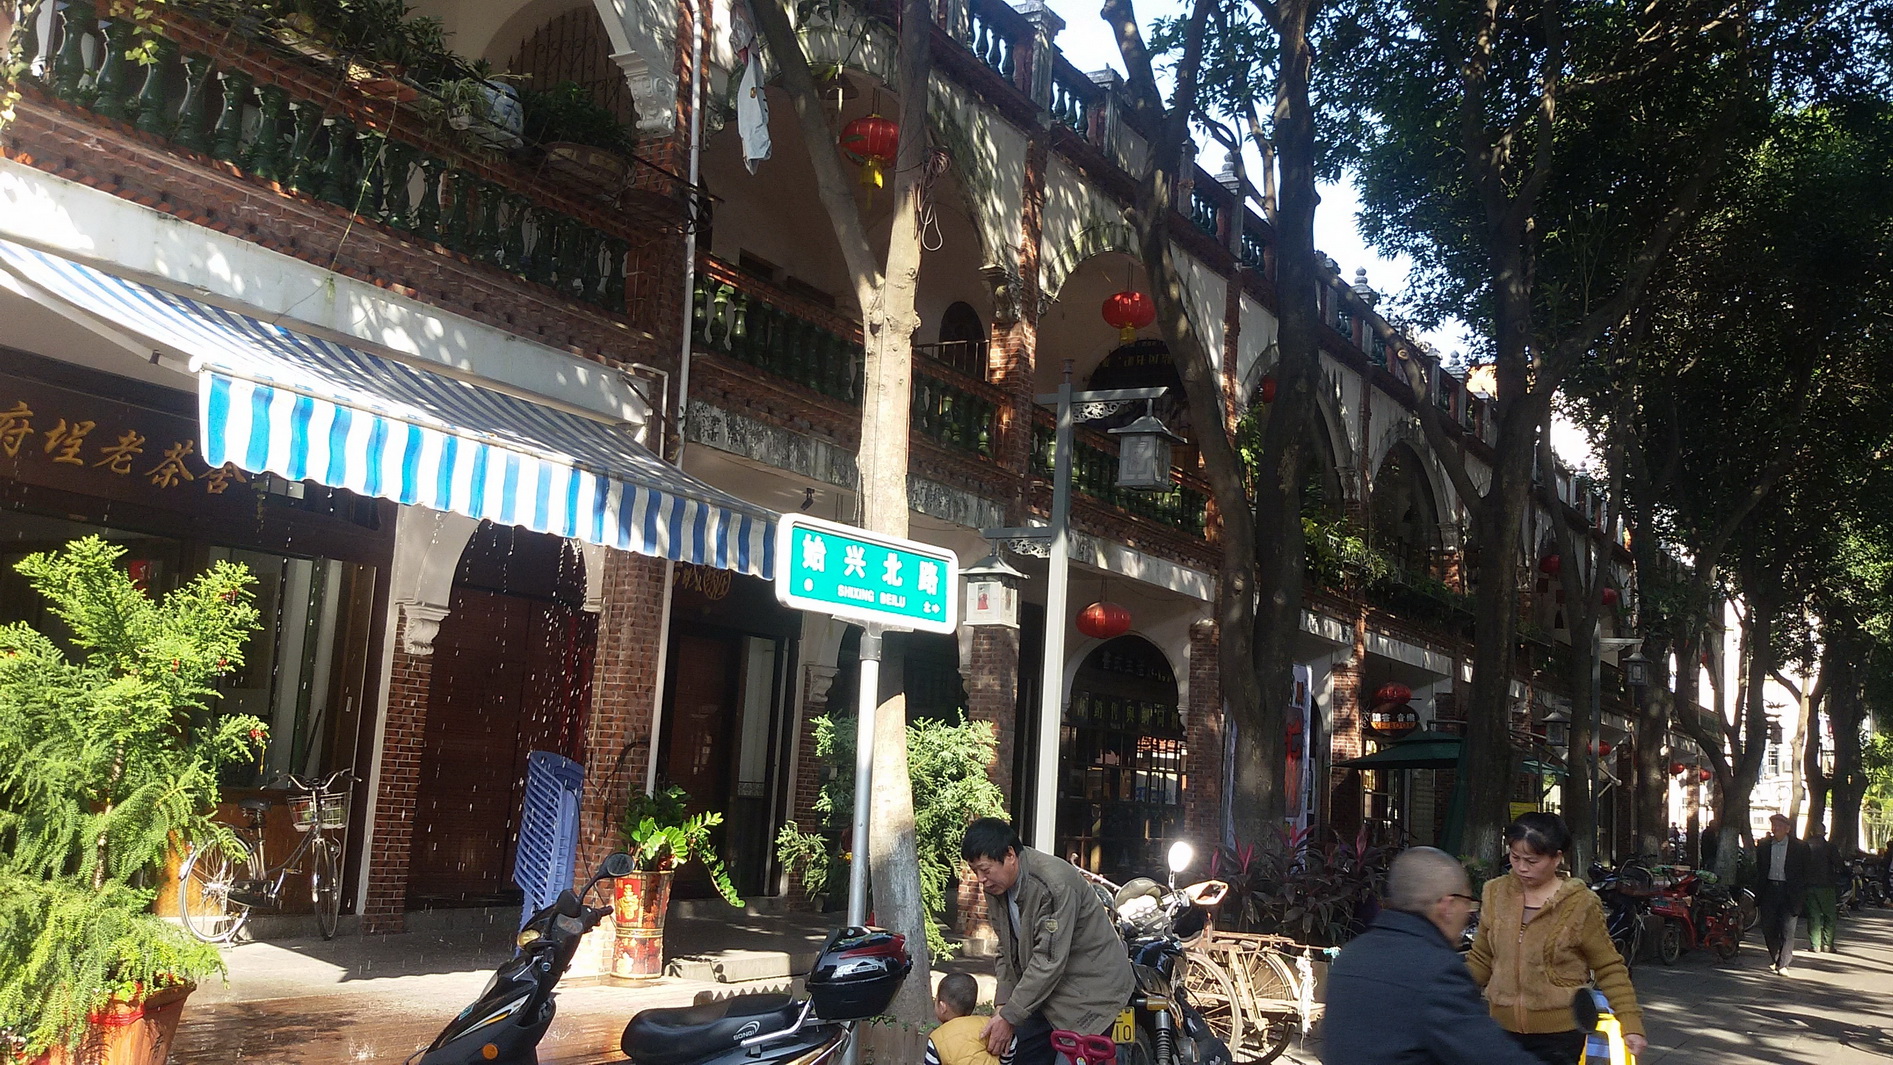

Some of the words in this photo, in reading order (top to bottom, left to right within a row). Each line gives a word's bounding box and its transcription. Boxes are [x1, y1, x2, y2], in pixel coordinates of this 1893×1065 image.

[802, 533, 939, 596] 始兴北路
[837, 584, 875, 603] SHIXING
[879, 591, 906, 608] BEILU
